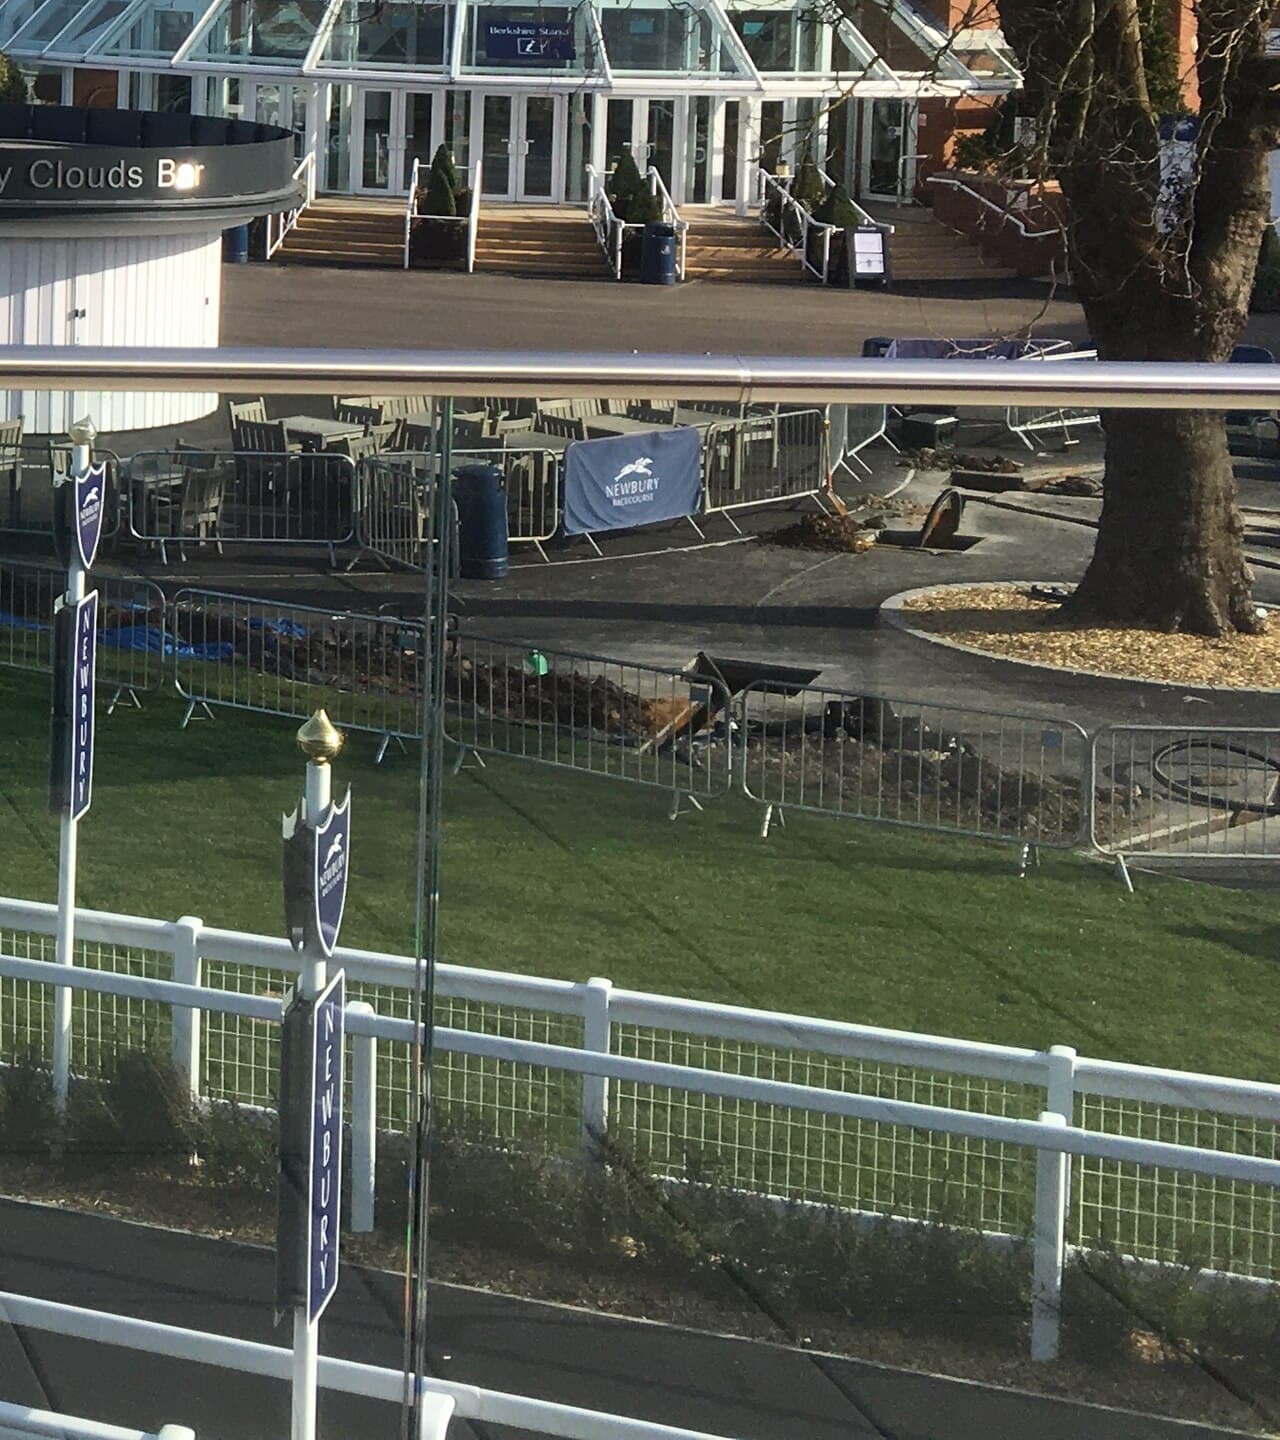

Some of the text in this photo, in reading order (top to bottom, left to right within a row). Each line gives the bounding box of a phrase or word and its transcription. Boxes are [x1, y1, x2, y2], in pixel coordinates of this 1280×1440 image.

[490, 25, 536, 36] Berkshire
[29, 158, 144, 189] Clouds
[605, 477, 660, 499] NEWBURY
[79, 607, 91, 802] NEWBURY
[319, 1001, 335, 1290] NEWBURY
